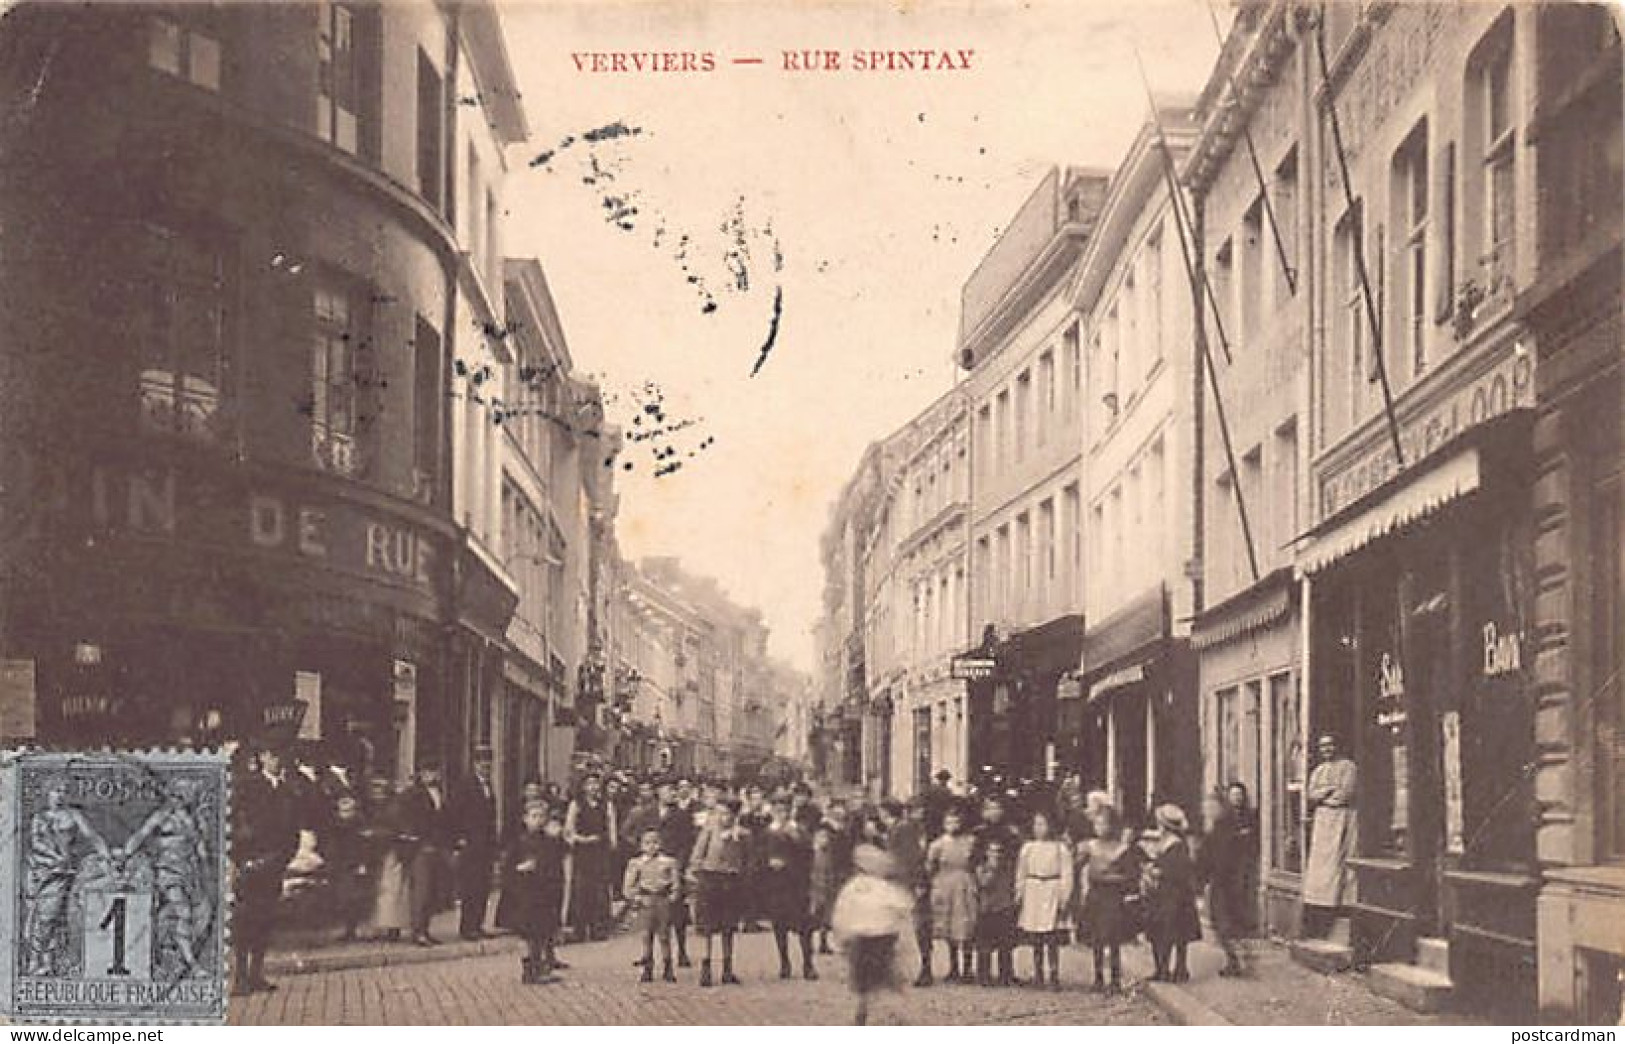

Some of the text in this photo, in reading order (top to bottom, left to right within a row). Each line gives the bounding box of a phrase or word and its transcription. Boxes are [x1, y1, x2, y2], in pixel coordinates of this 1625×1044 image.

[251, 497, 327, 556] DE
[366, 521, 434, 583] RUE
[99, 898, 131, 976] 1
